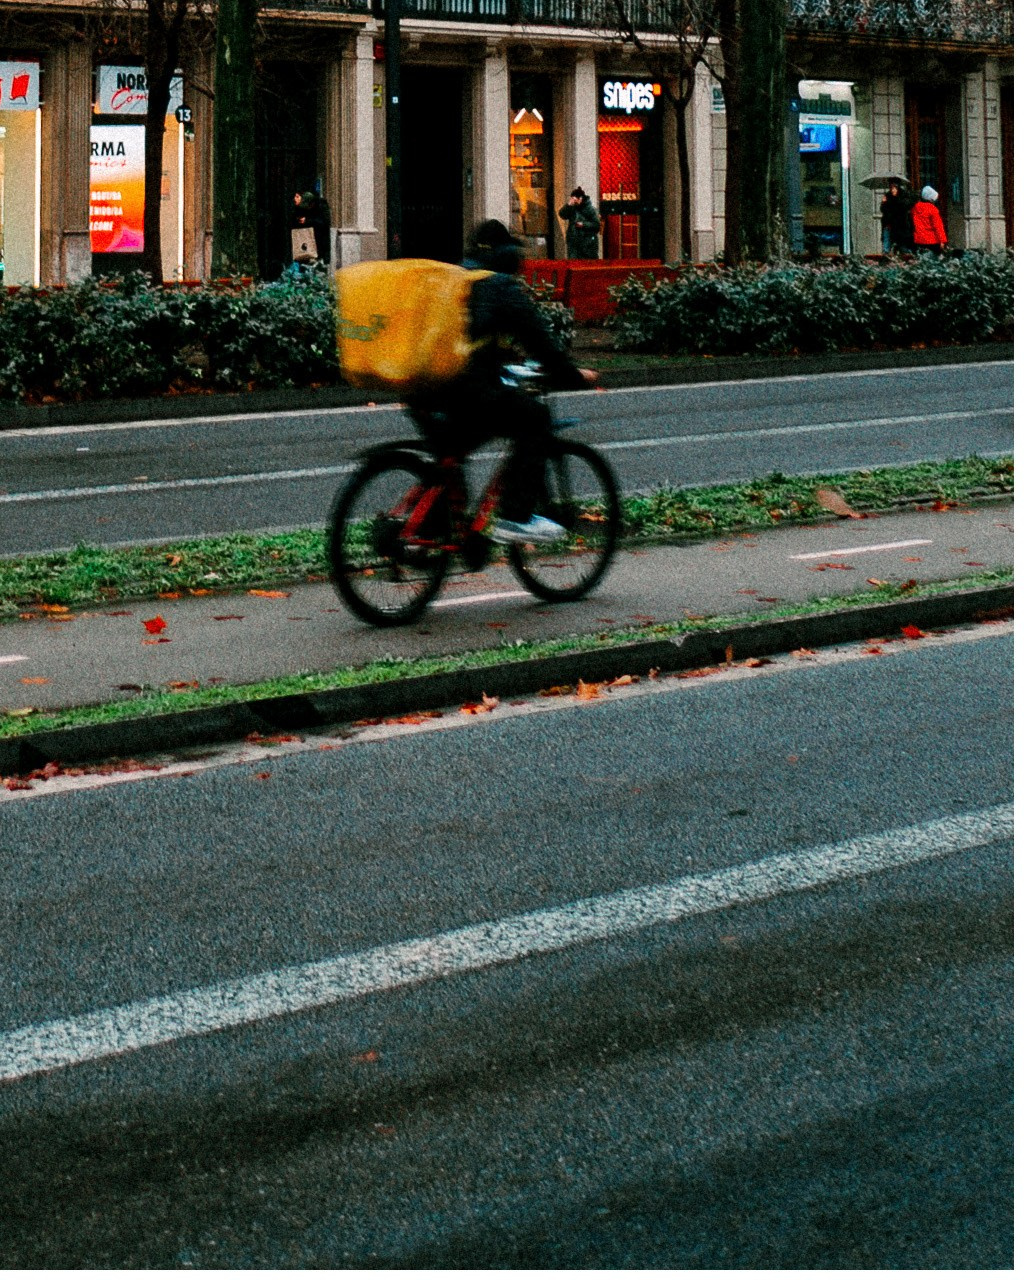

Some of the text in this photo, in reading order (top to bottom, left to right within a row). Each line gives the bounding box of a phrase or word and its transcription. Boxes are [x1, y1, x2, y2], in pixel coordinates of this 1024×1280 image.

[116, 72, 148, 91] NOR
[111, 87, 148, 111] Com
[178, 108, 192, 122] 13
[90, 141, 125, 156] RMA
